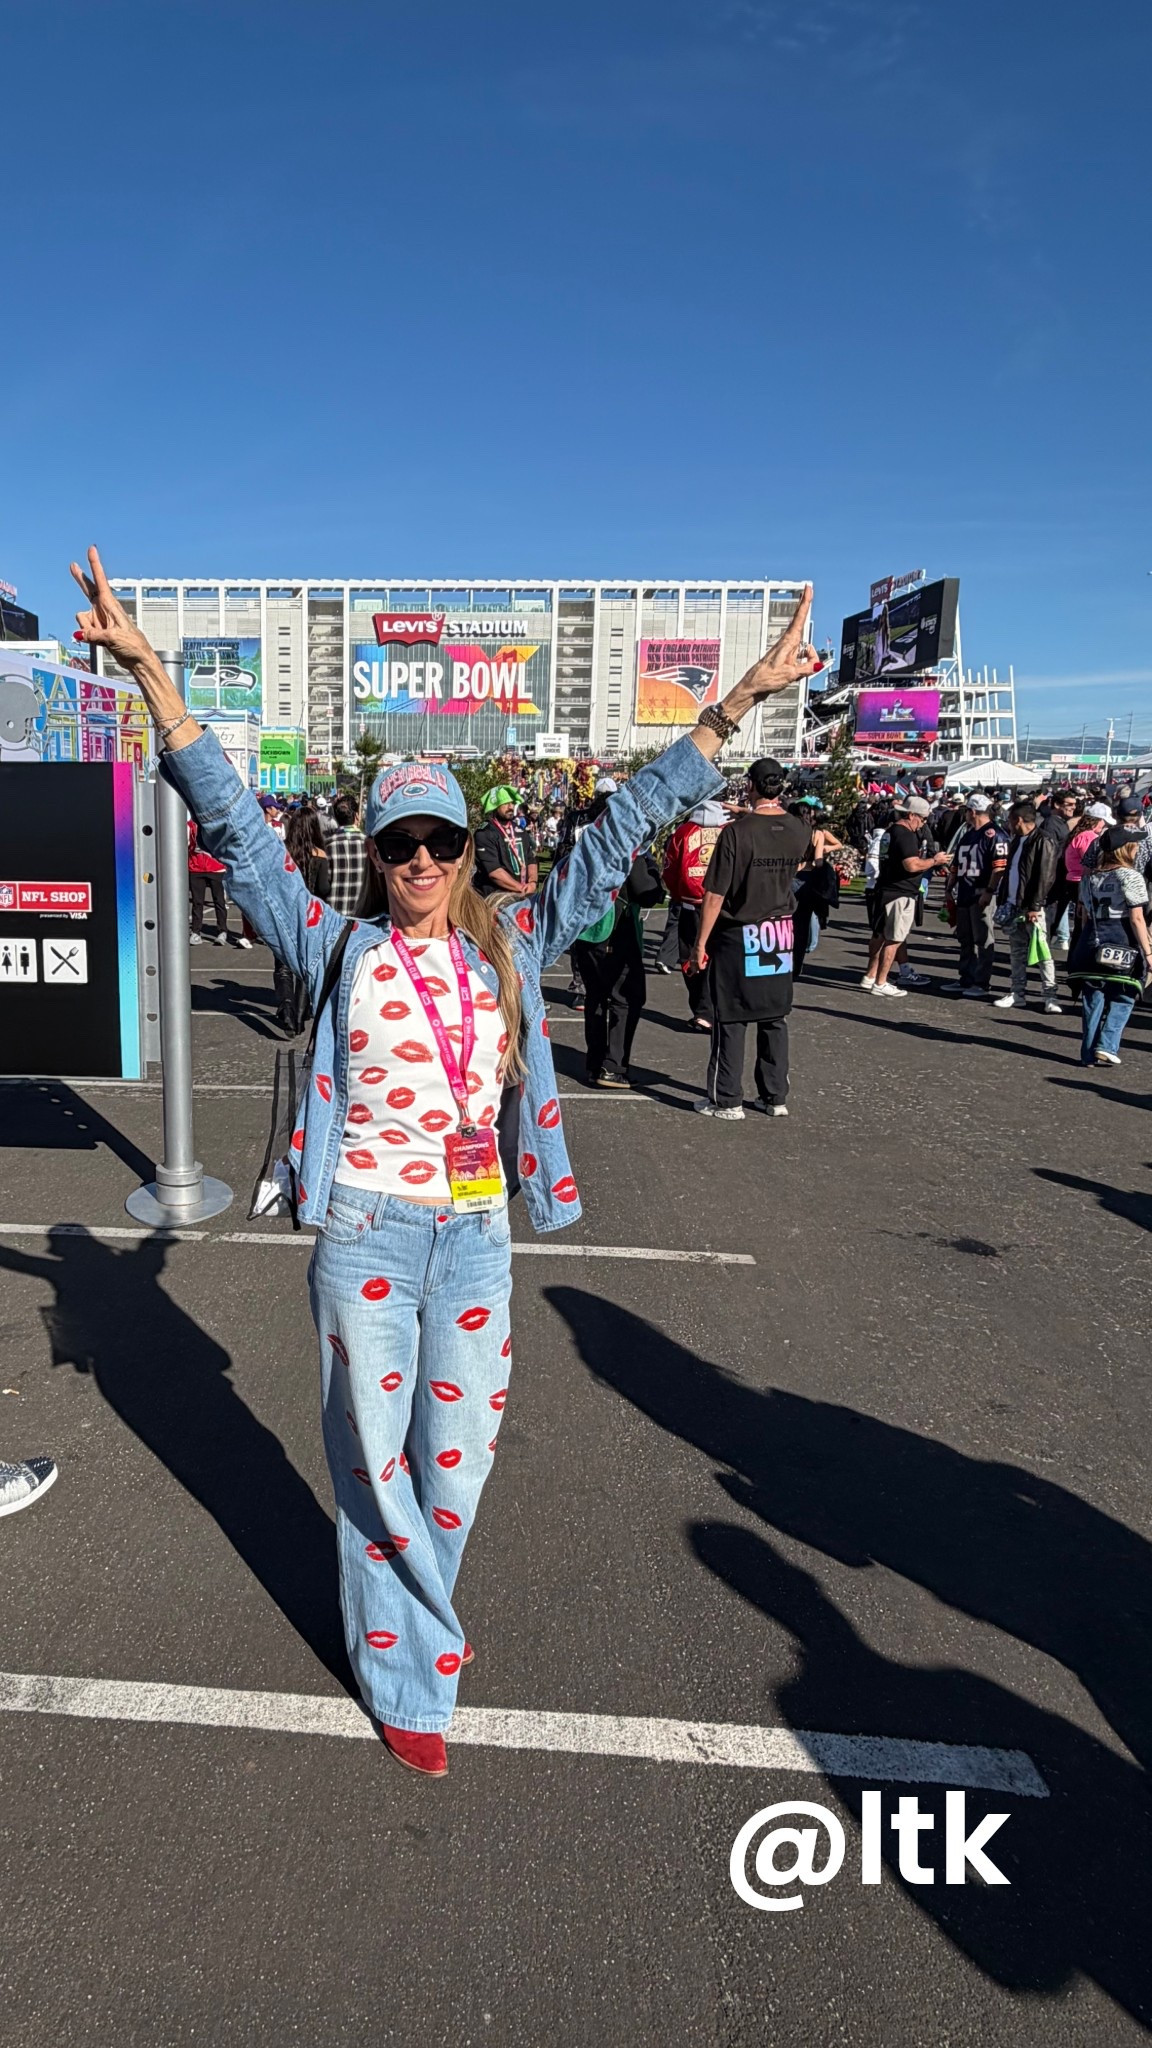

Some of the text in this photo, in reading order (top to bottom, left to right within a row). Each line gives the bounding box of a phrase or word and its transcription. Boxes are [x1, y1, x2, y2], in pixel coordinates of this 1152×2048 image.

[449, 620, 529, 635] STADIUM
[648, 643, 720, 653] NEW ENGLAND PATRIOTS
[647, 653, 661, 662] NEW
[663, 653, 690, 662] ENGLAND
[353, 661, 533, 699] SUPER BOWL
[995, 842, 1009, 856] 51
[752, 857, 800, 867] ESSENTIALS
[957, 843, 981, 877] 51
[22, 891, 87, 903] NFL SHOP
[69, 911, 88, 920] VISA
[742, 919, 794, 954] BOW
[452, 1141, 490, 1152] CHAMPIONS
